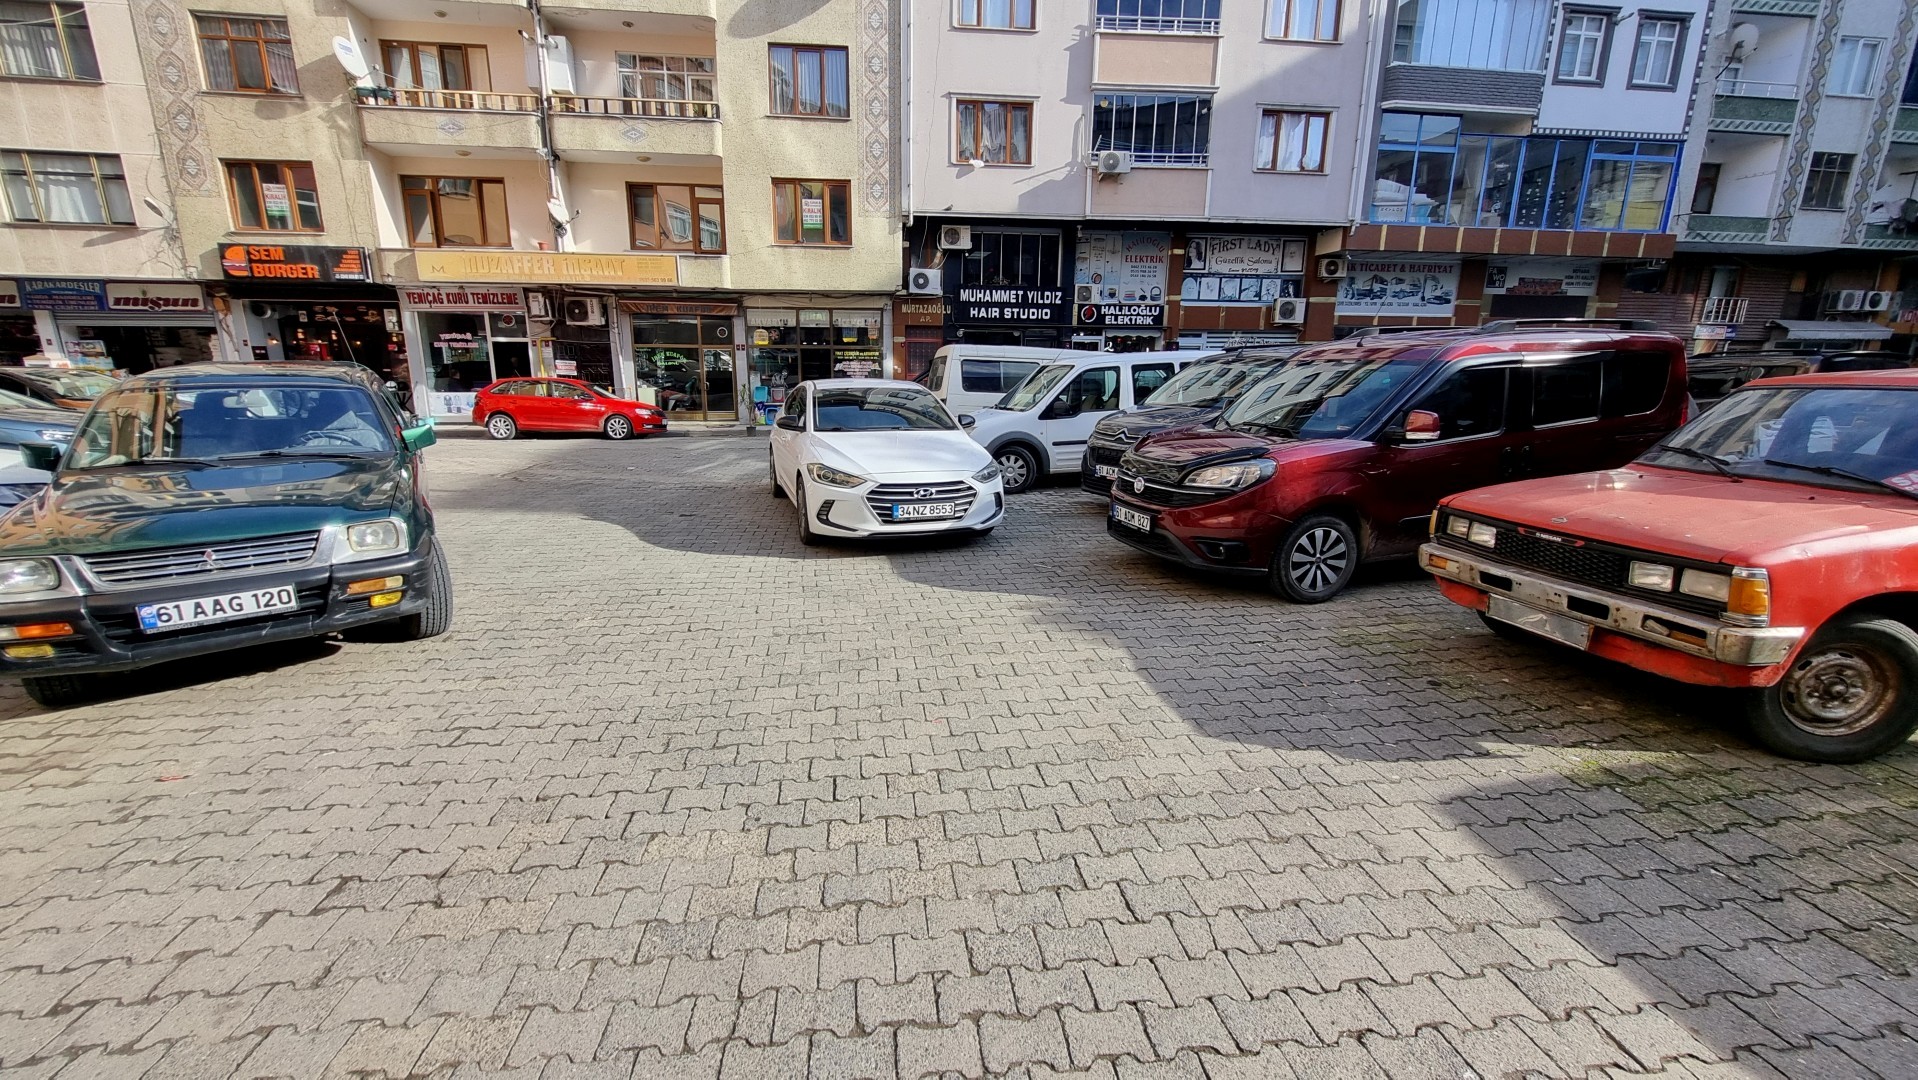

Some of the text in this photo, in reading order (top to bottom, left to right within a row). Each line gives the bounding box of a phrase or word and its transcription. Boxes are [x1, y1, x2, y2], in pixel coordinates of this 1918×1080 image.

[250, 246, 284, 260] SEM
[1247, 238, 1278, 255] LADY
[251, 264, 320, 279] BURGER
[462, 255, 555, 275] MUZAFFER
[1360, 261, 1398, 272] TİCARET
[1400, 264, 1407, 272] &
[445, 292, 470, 305] KURU
[960, 289, 1062, 304] MUHAMMET YILDIZ
[901, 303, 951, 314] MURTAZAOĞLU
[970, 307, 1051, 320] HAIR STUDIO
[900, 506, 911, 516] 34
[912, 505, 928, 516] NZ
[929, 504, 954, 515] 8553
[1116, 506, 1122, 519] 61
[1138, 514, 1149, 529] 827
[156, 588, 292, 624] 61 AAG 120
